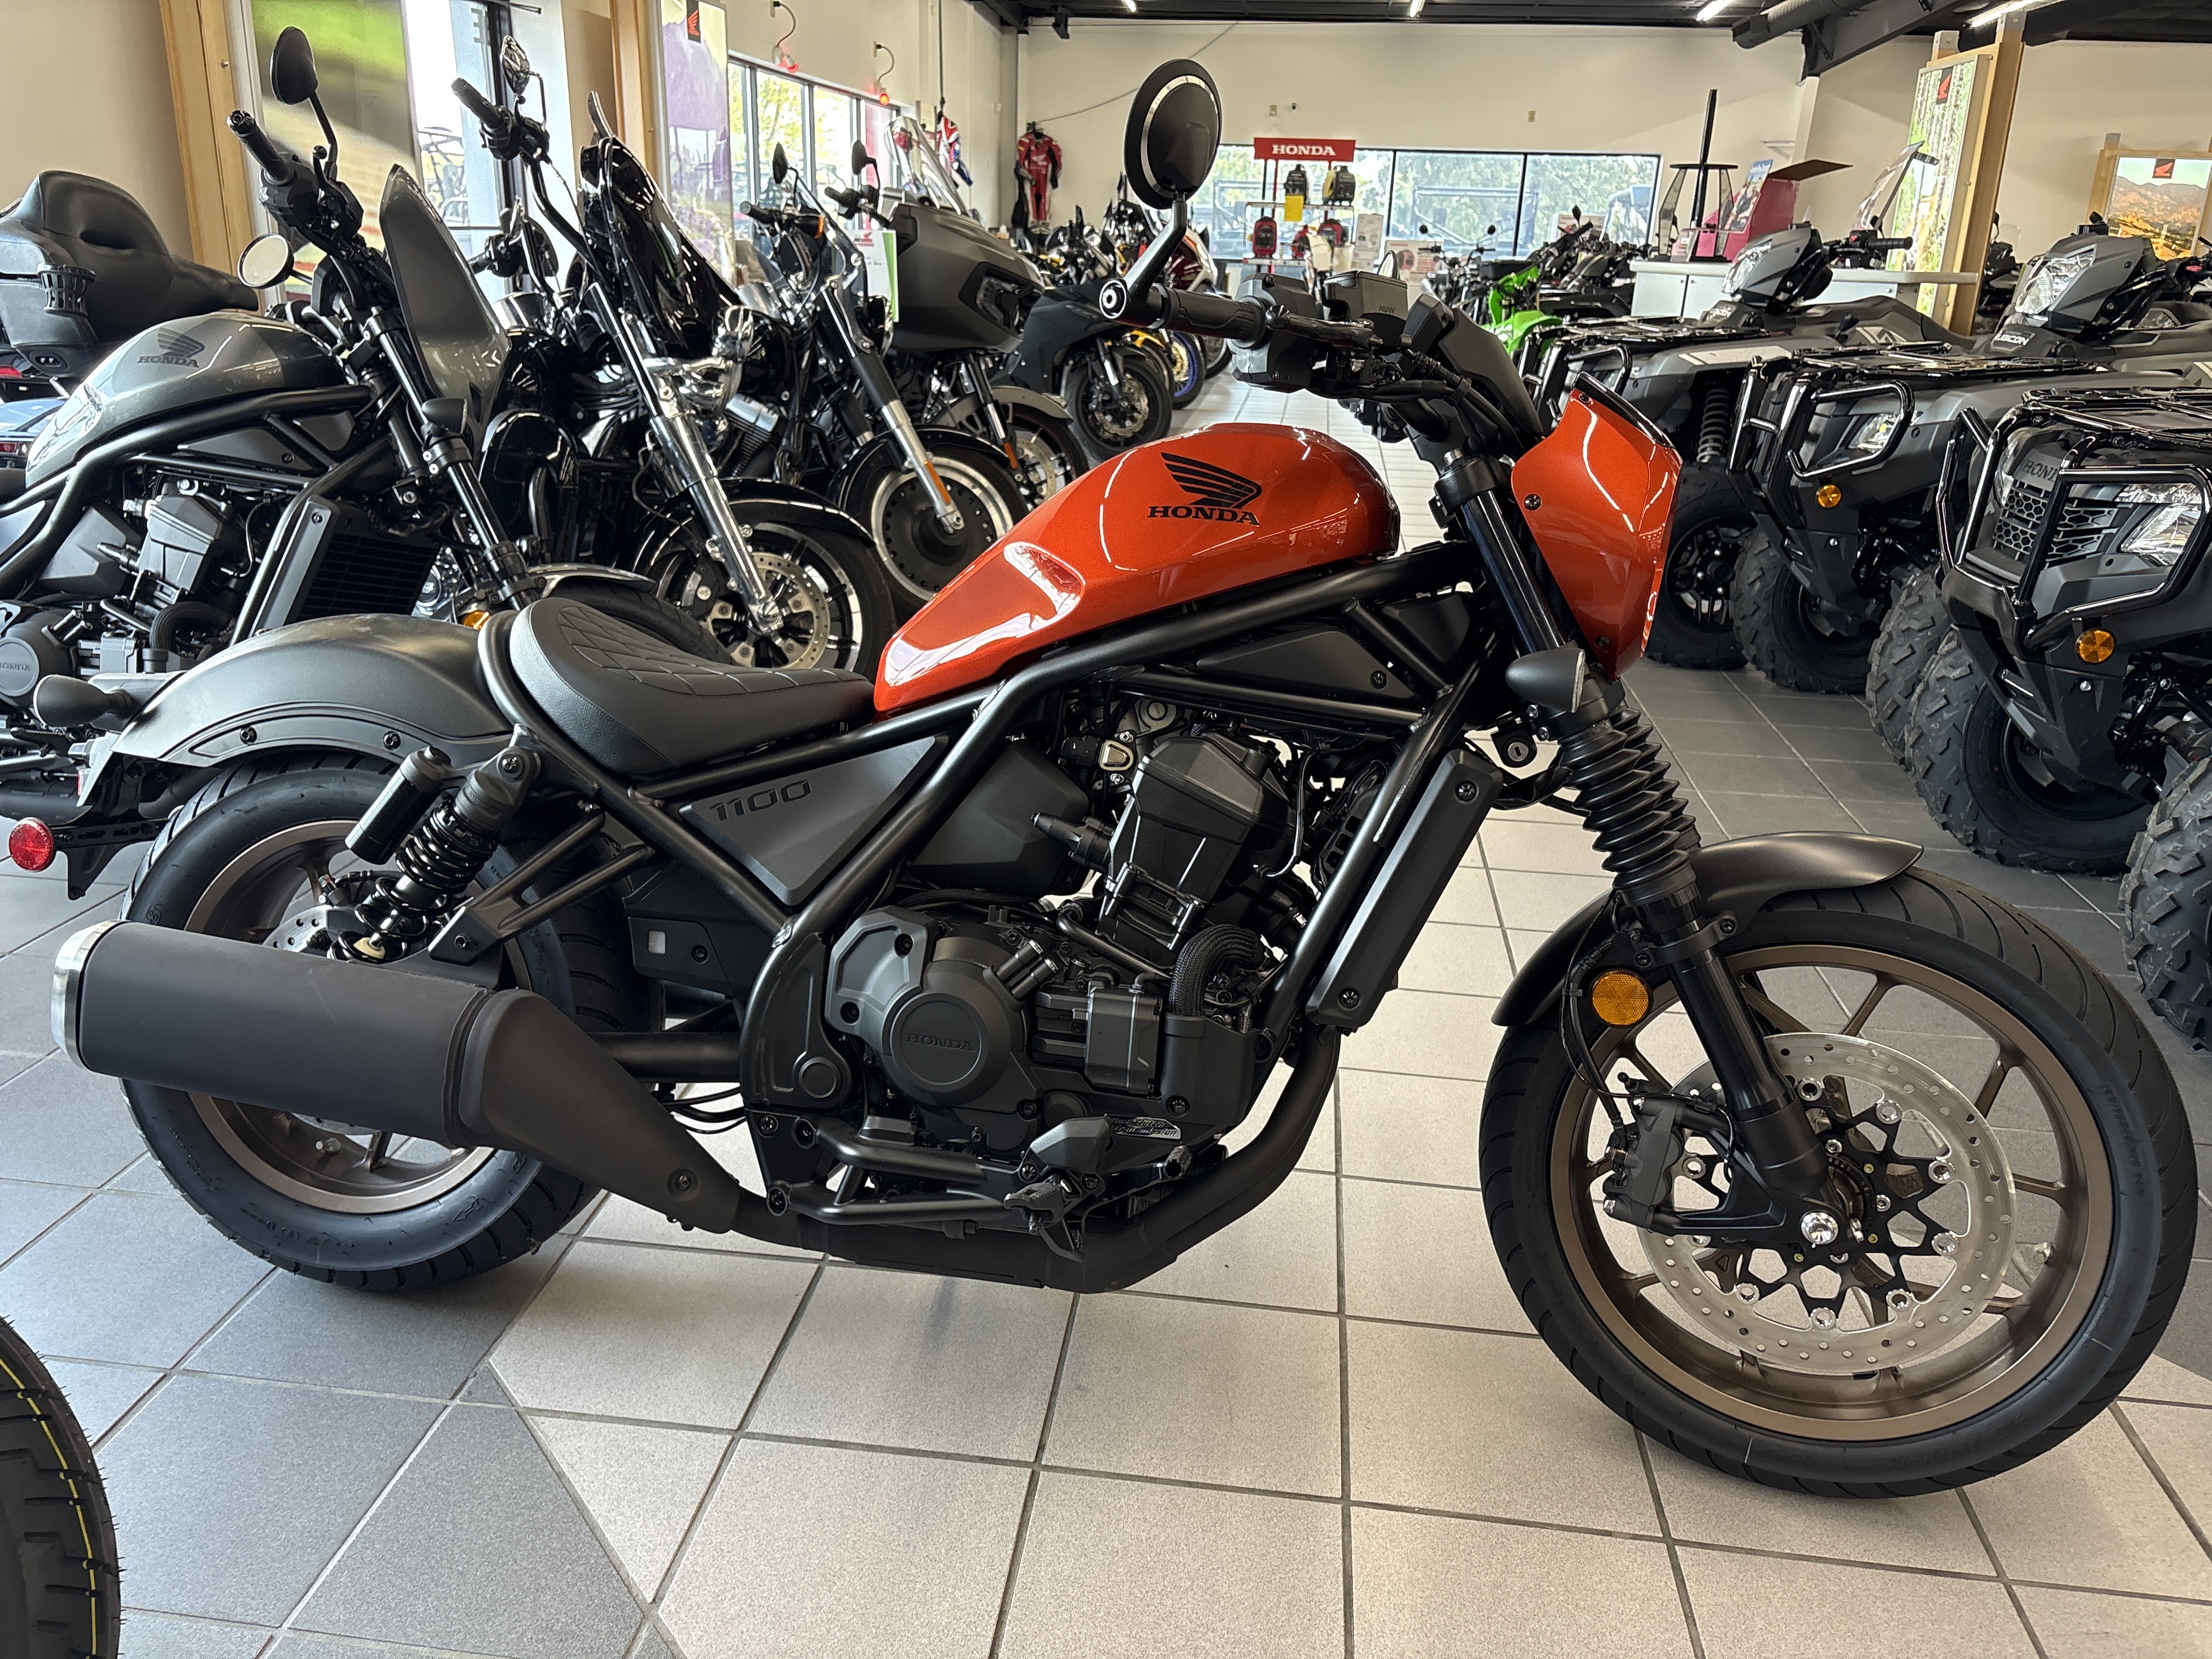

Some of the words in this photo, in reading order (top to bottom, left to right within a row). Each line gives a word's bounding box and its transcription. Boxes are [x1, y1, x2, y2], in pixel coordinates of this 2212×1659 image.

[1271, 144, 1336, 156] HONDA
[137, 356, 200, 368] HONDA
[1147, 505, 1261, 527] HONDA
[709, 779, 812, 821] 1100
[906, 1033, 976, 1052] HONDA
